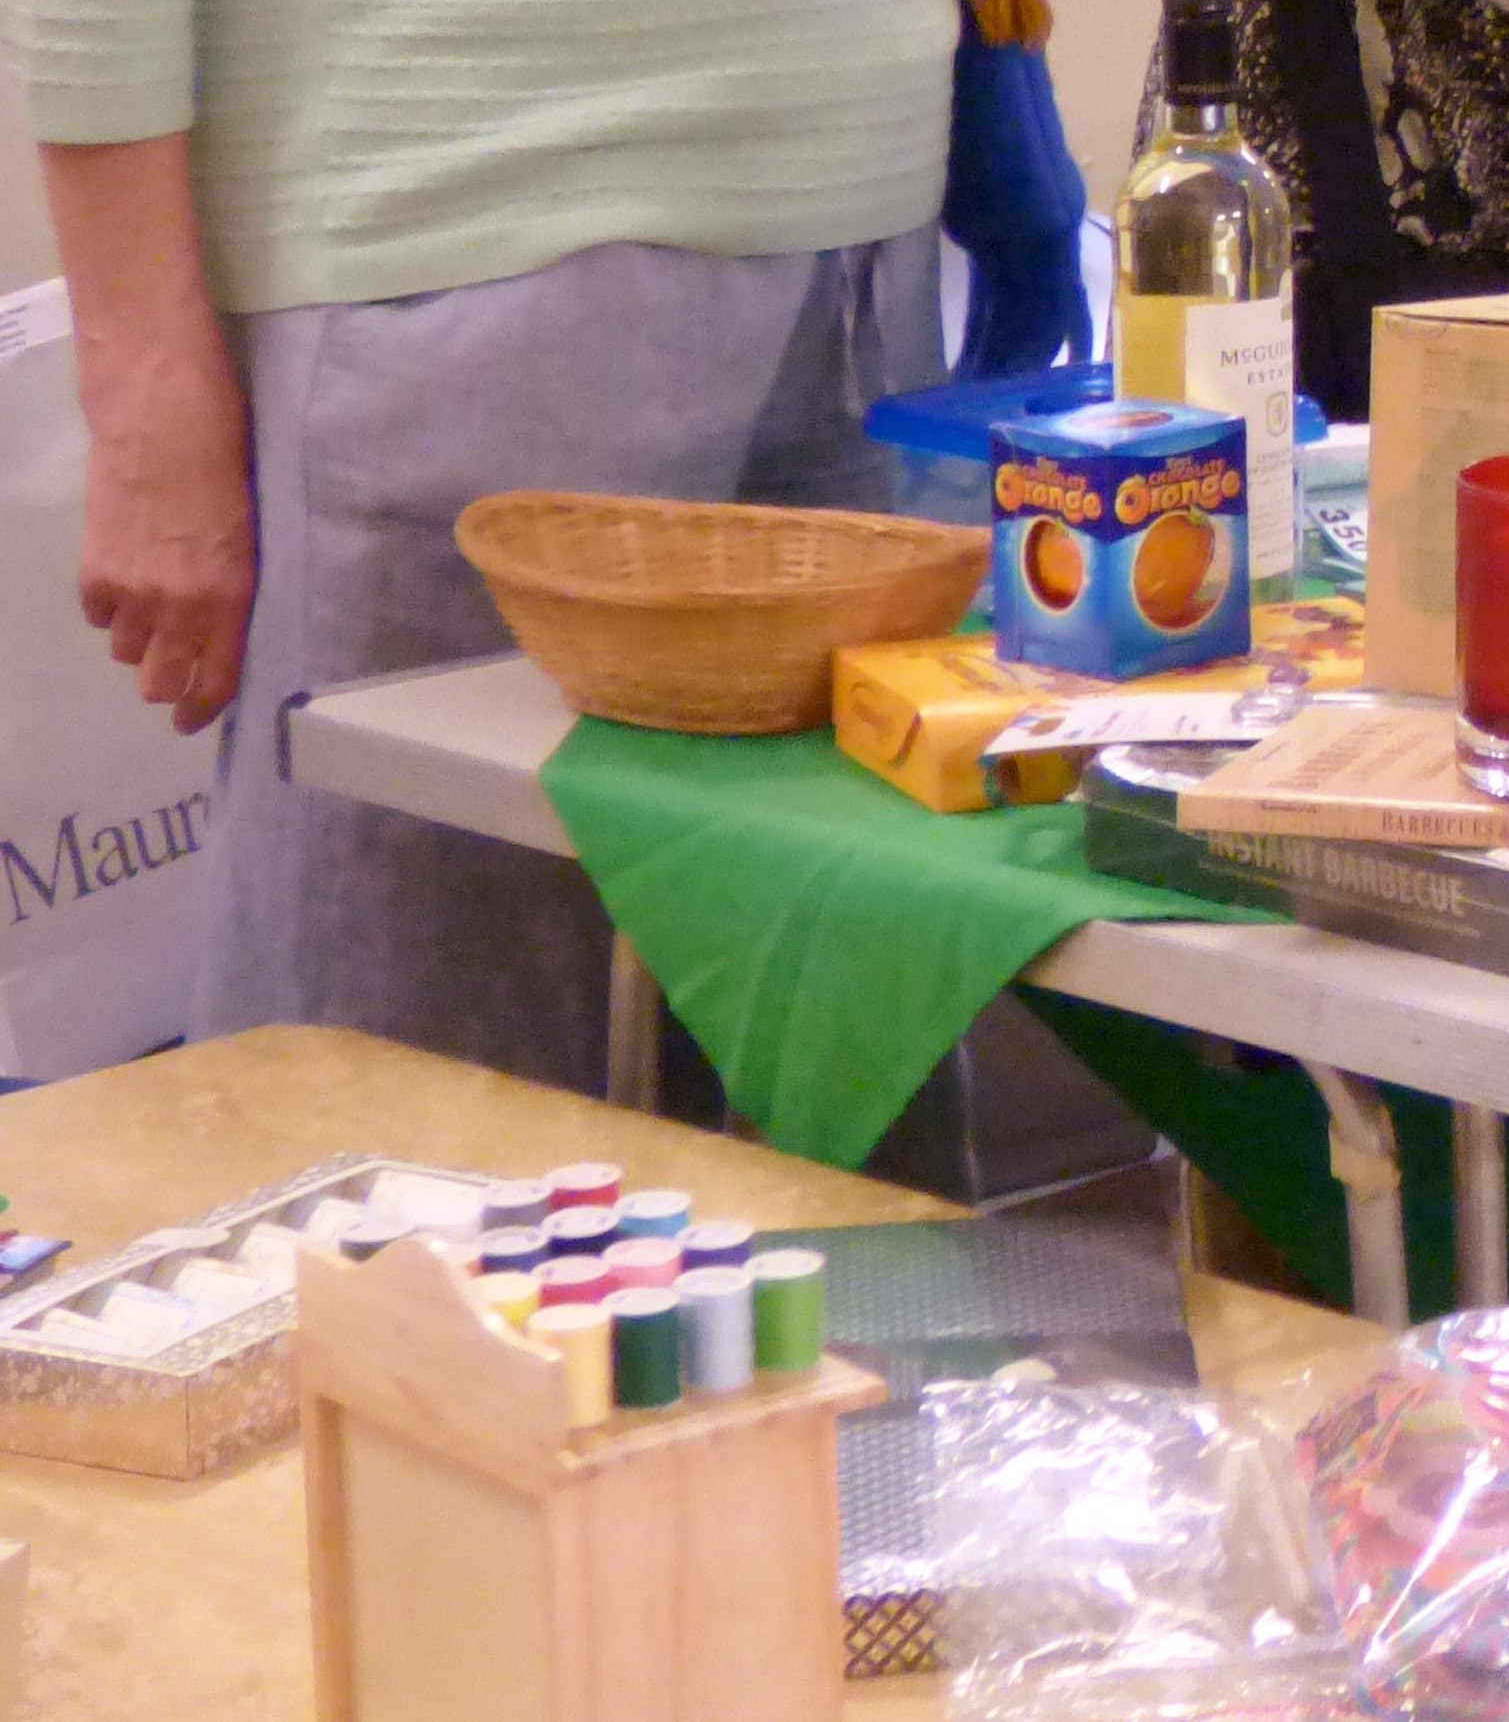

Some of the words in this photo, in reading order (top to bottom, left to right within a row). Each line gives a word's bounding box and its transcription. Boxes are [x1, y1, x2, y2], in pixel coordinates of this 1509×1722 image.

[996, 463, 1103, 524] Orange
[1115, 469, 1241, 525] Orange
[0, 791, 210, 926] Maur
